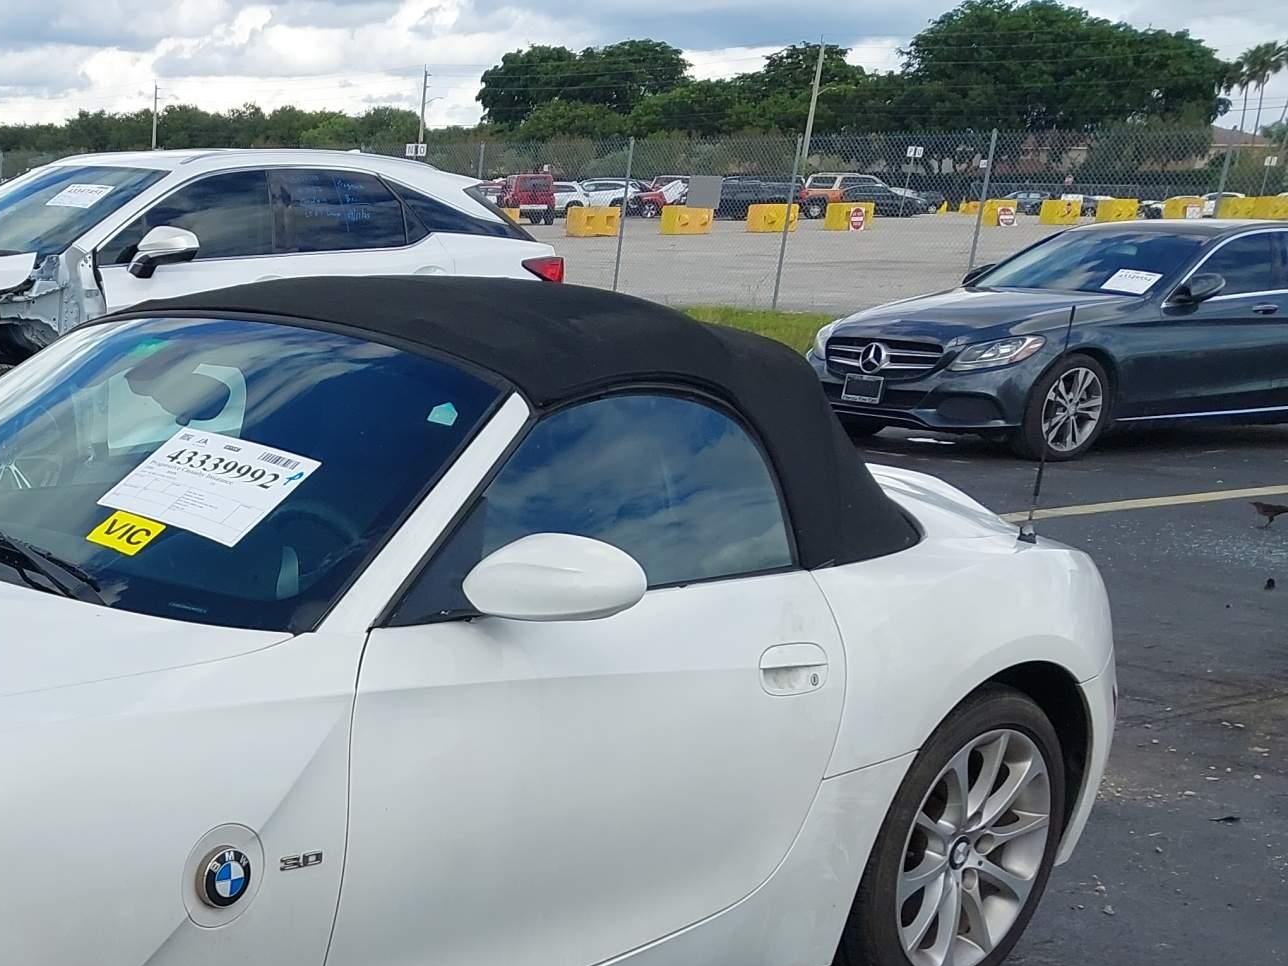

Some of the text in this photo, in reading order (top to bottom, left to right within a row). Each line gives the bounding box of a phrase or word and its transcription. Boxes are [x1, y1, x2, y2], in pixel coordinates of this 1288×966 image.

[166, 448, 280, 489] 43339992
[104, 518, 152, 546] VIC
[209, 851, 250, 873] BMW
